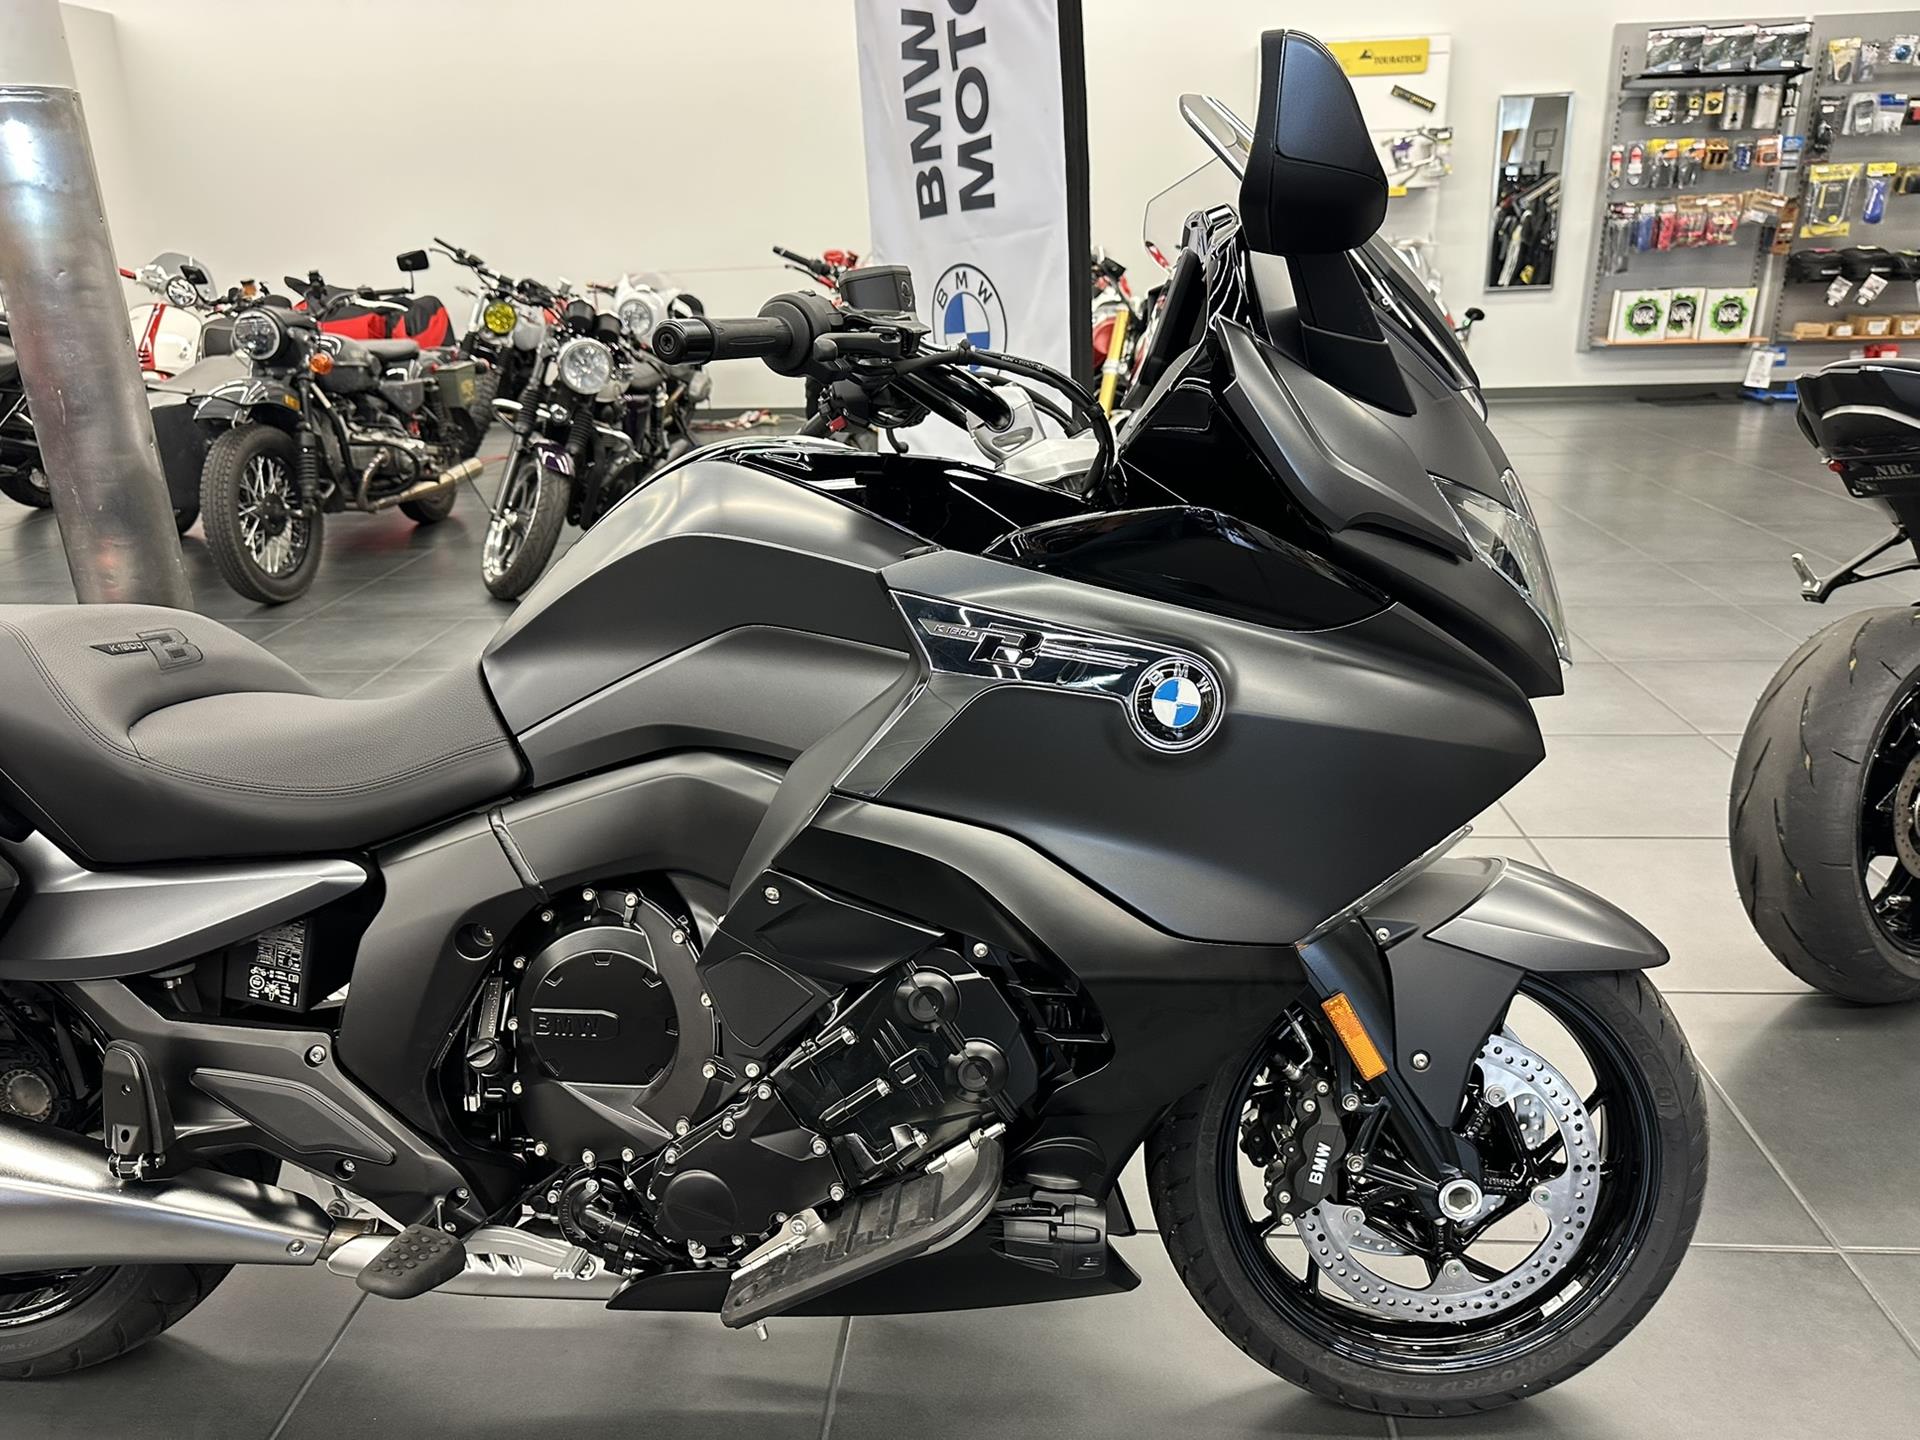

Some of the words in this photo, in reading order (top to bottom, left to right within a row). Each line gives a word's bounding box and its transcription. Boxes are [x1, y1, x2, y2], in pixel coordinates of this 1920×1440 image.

[900, 8, 948, 220] BMW
[947, 0, 996, 212] MOT
[936, 270, 992, 310] BMW
[1873, 463, 1914, 476] NRC
[1148, 662, 1212, 694] BMW
[535, 1016, 599, 1036] BMW
[1308, 1141, 1332, 1185] BMW
